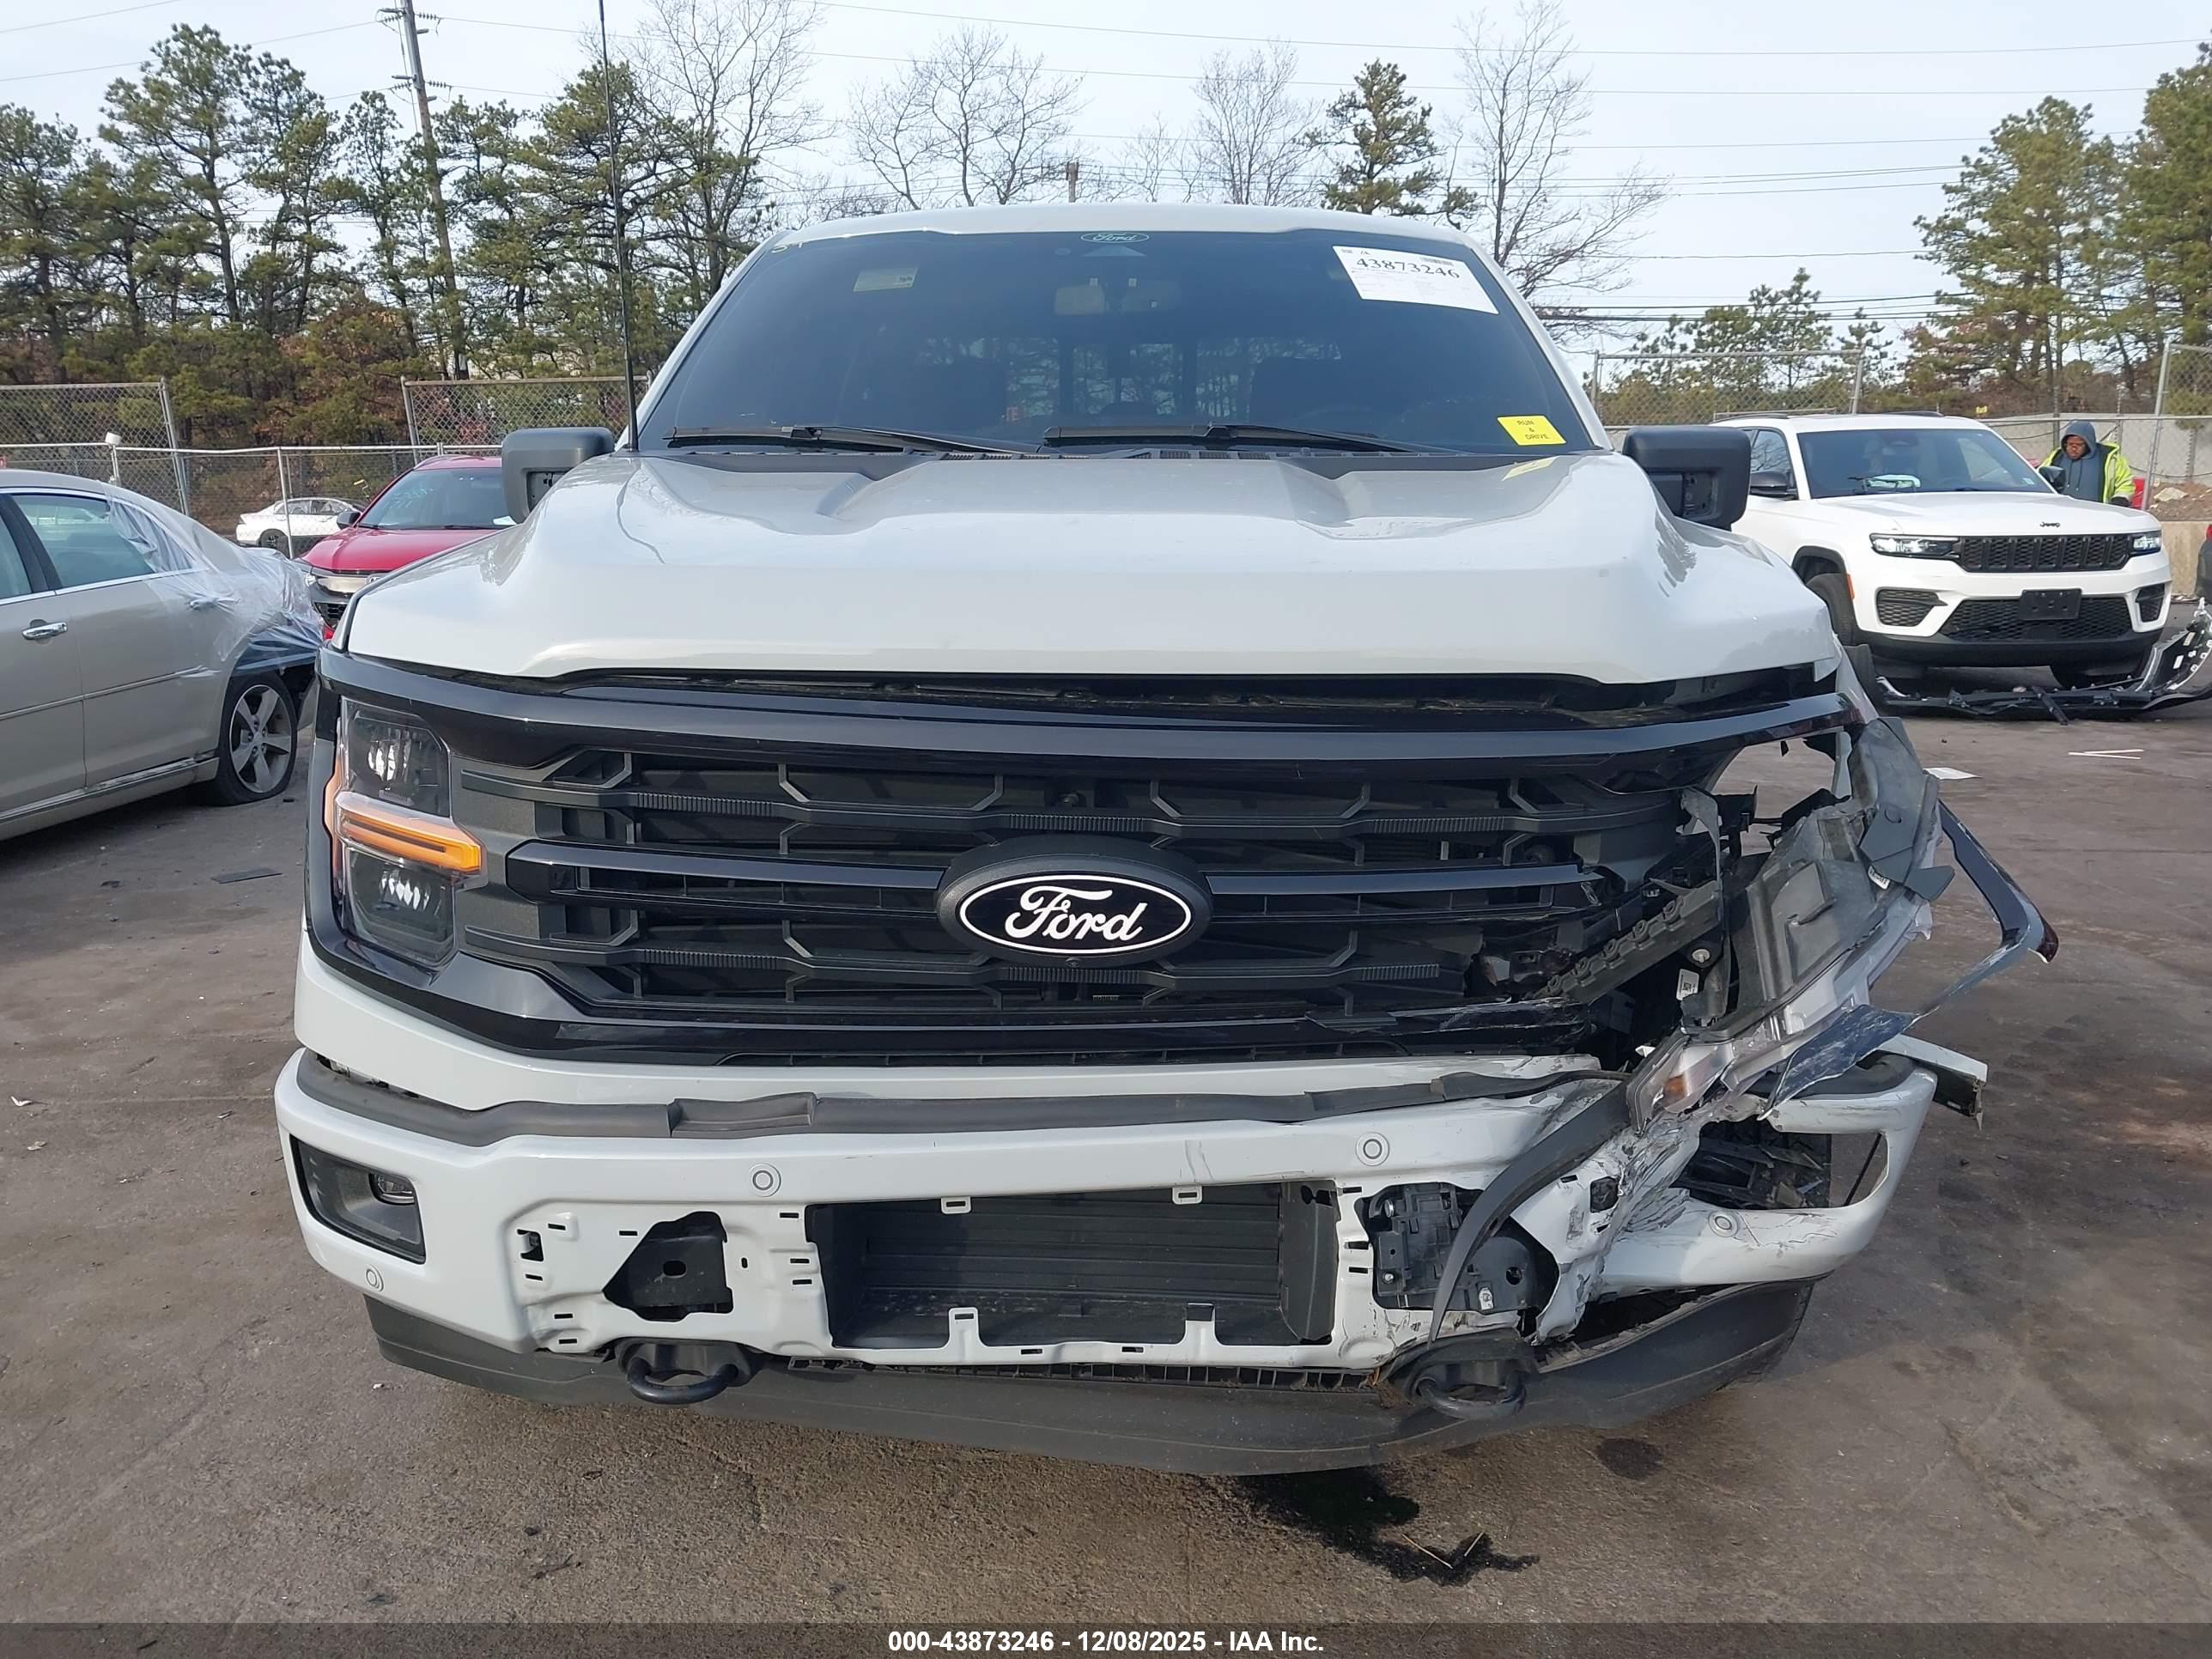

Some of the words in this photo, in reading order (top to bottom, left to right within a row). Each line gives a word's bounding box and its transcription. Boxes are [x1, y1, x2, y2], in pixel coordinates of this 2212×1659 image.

[1093, 232, 1138, 241] Ford
[1357, 258, 1461, 279] 43873246
[1005, 885, 1148, 941] Ford
